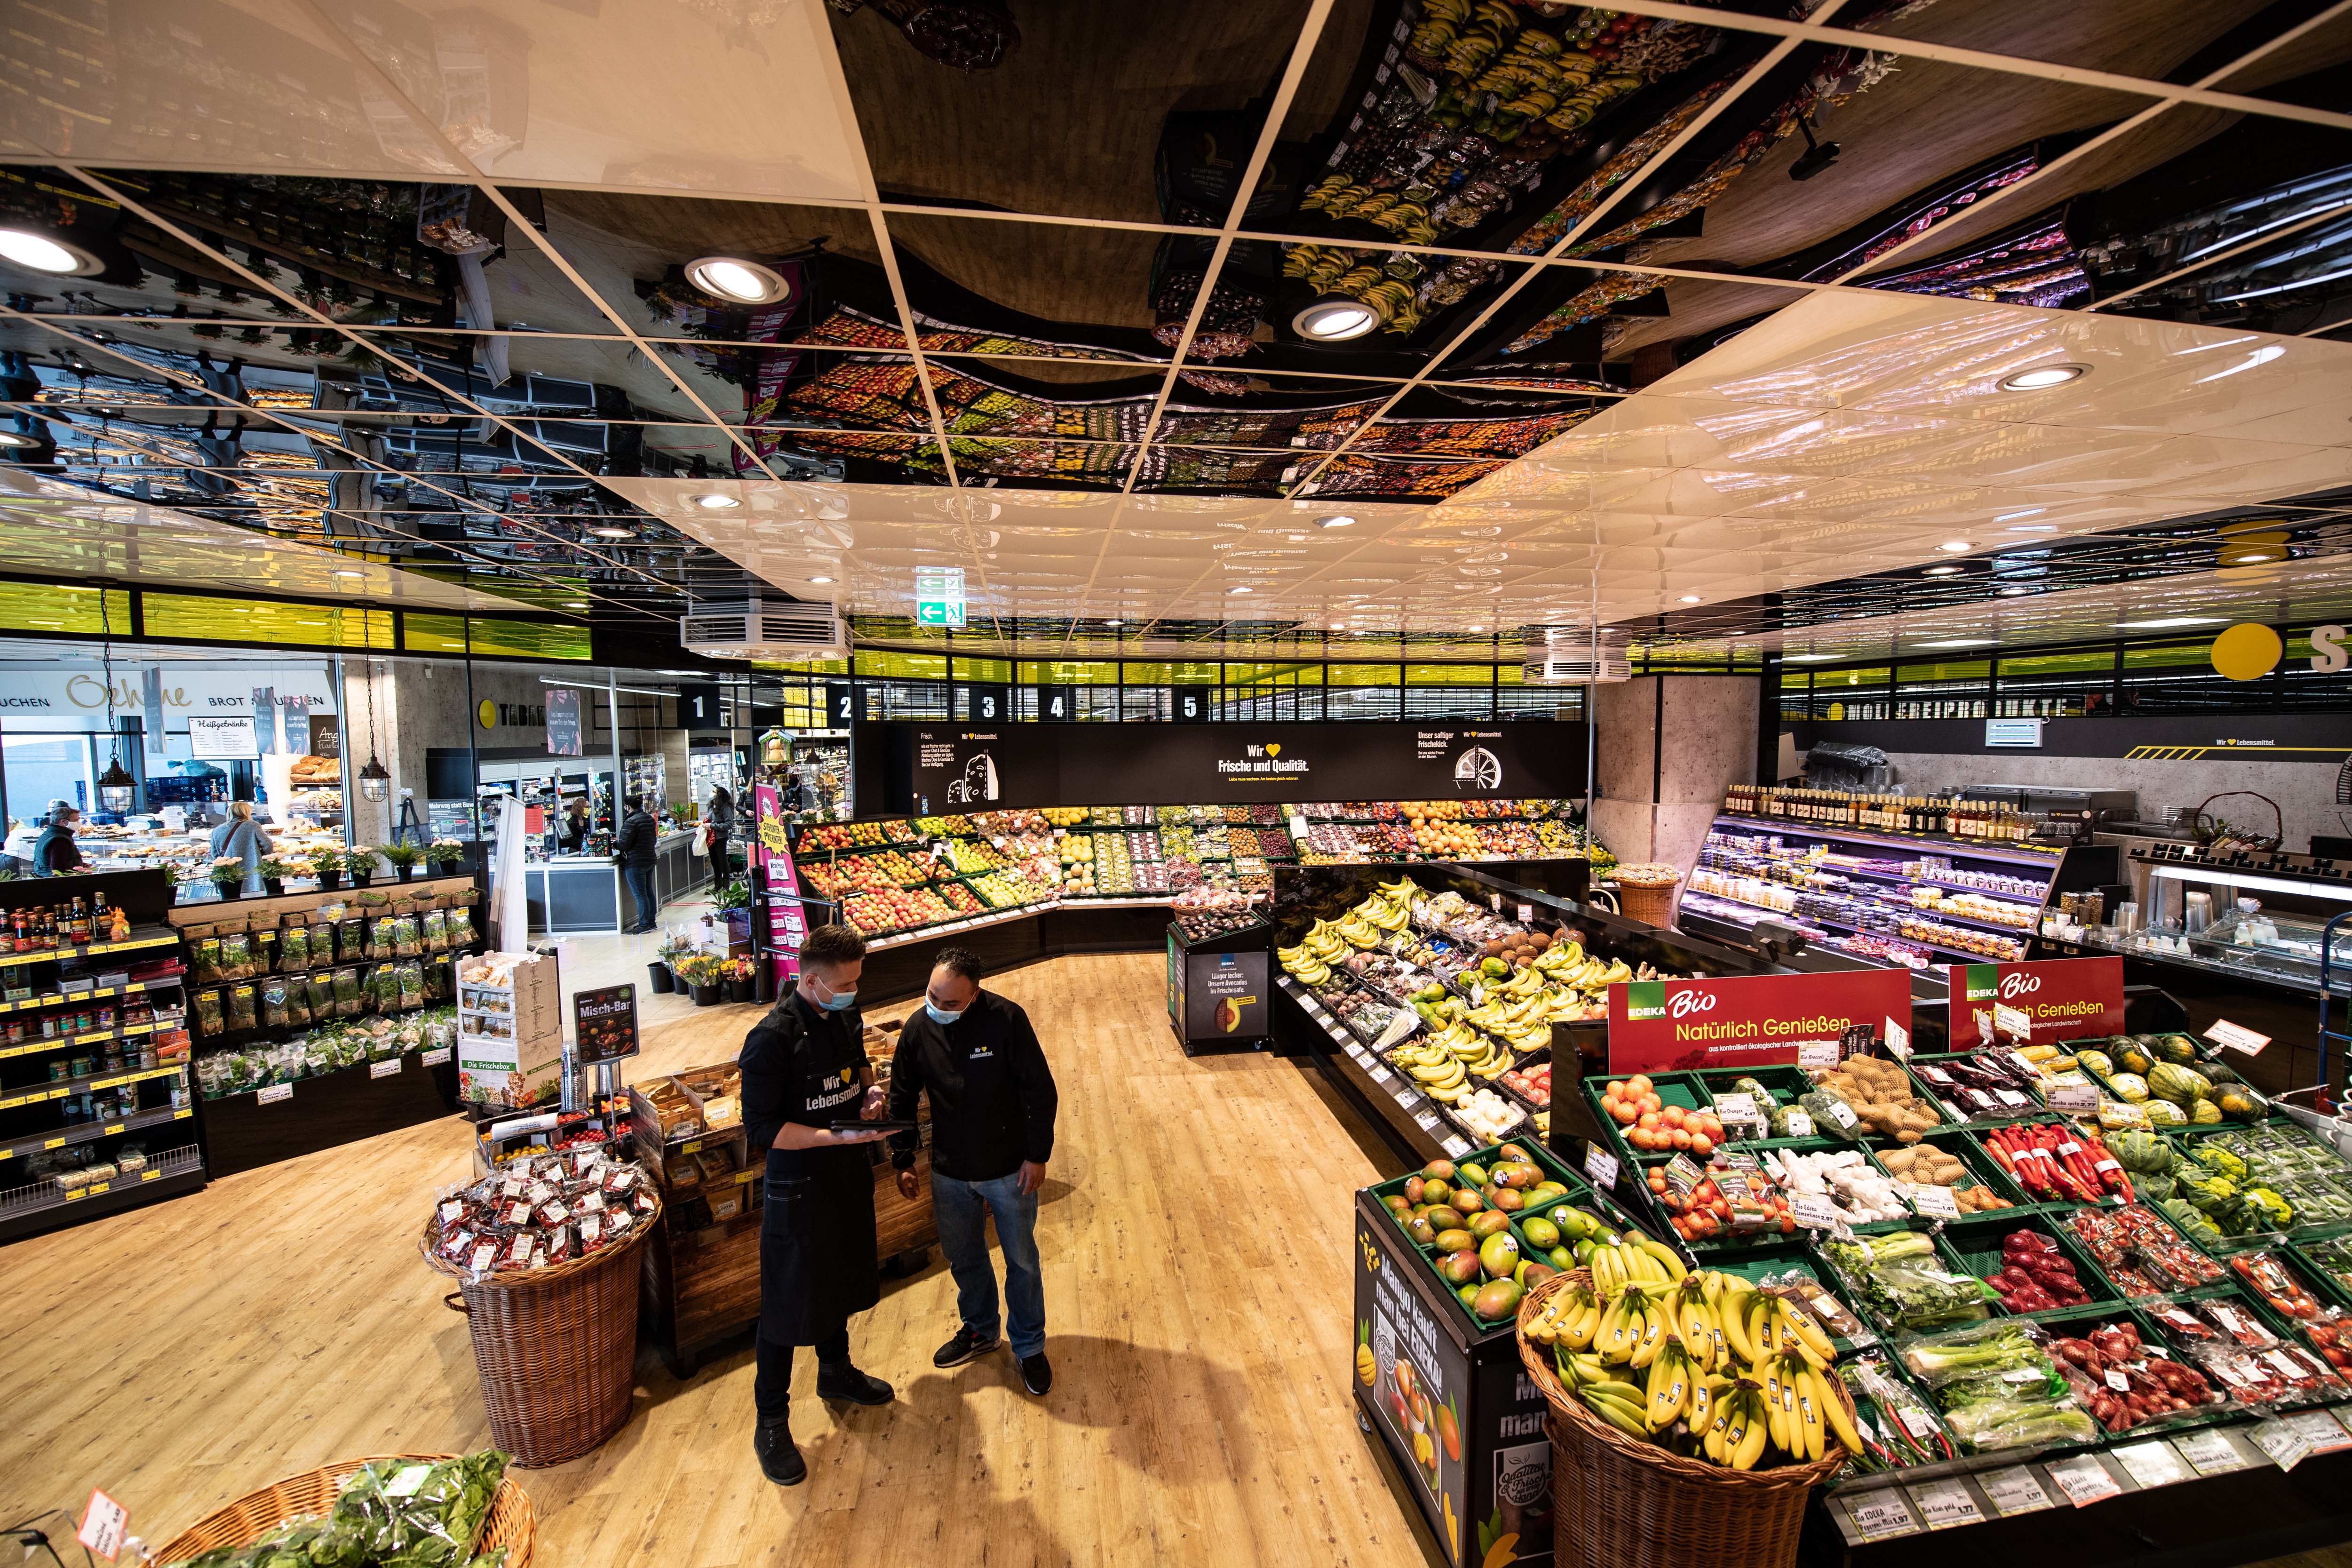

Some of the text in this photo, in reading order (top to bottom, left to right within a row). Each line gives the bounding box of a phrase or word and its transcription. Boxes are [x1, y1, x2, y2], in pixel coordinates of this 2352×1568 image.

[2311, 625, 2347, 673] S
[500, 704, 546, 726] TABAK
[693, 697, 703, 717] 1
[841, 697, 851, 717] 2
[983, 697, 994, 717] 3
[1051, 697, 1064, 716] 4
[1184, 697, 1196, 716] 5
[197, 719, 248, 730] Heißgetränke
[1248, 745, 1264, 756] Wir
[1218, 759, 1309, 773] Frische und Qualität.
[1967, 972, 2041, 999] EDEKA Bio
[580, 1001, 631, 1018] Misch-Bar
[1628, 990, 1716, 1019] EDEKA Bio
[2038, 1001, 2104, 1018] Genießen
[1676, 1016, 1851, 1041] Natürlich Genießen
[1997, 1018, 2018, 1029] Zuckermais
[1719, 1043, 1748, 1051] kontrolliert
[1748, 1042, 1781, 1051] ökologischer
[479, 1062, 510, 1070] Frischebox
[823, 1075, 840, 1091] Wir
[806, 1082, 860, 1111] Lebensmittel
[1794, 1210, 1820, 1219] Clementinen
[1382, 1252, 1437, 1355] Mango kauft
[1376, 1280, 1442, 1395] man bei EDEKA!
[1501, 1411, 1547, 1438] man
[1501, 1462, 1546, 1483] Qualität
[1501, 1470, 1553, 1495] & Frische
[1526, 1483, 1540, 1493] erster
[1512, 1488, 1540, 1504] Hand
[2026, 1491, 2042, 1501] 1,97
[1854, 1508, 1886, 1523] Bio EDEKA
[1931, 1504, 1943, 1512] Kiwi
[1944, 1502, 1956, 1512] gold
[1958, 1504, 1974, 1514] 1,77
[1859, 1514, 1909, 1532] Peperoni-Mix 1,97
